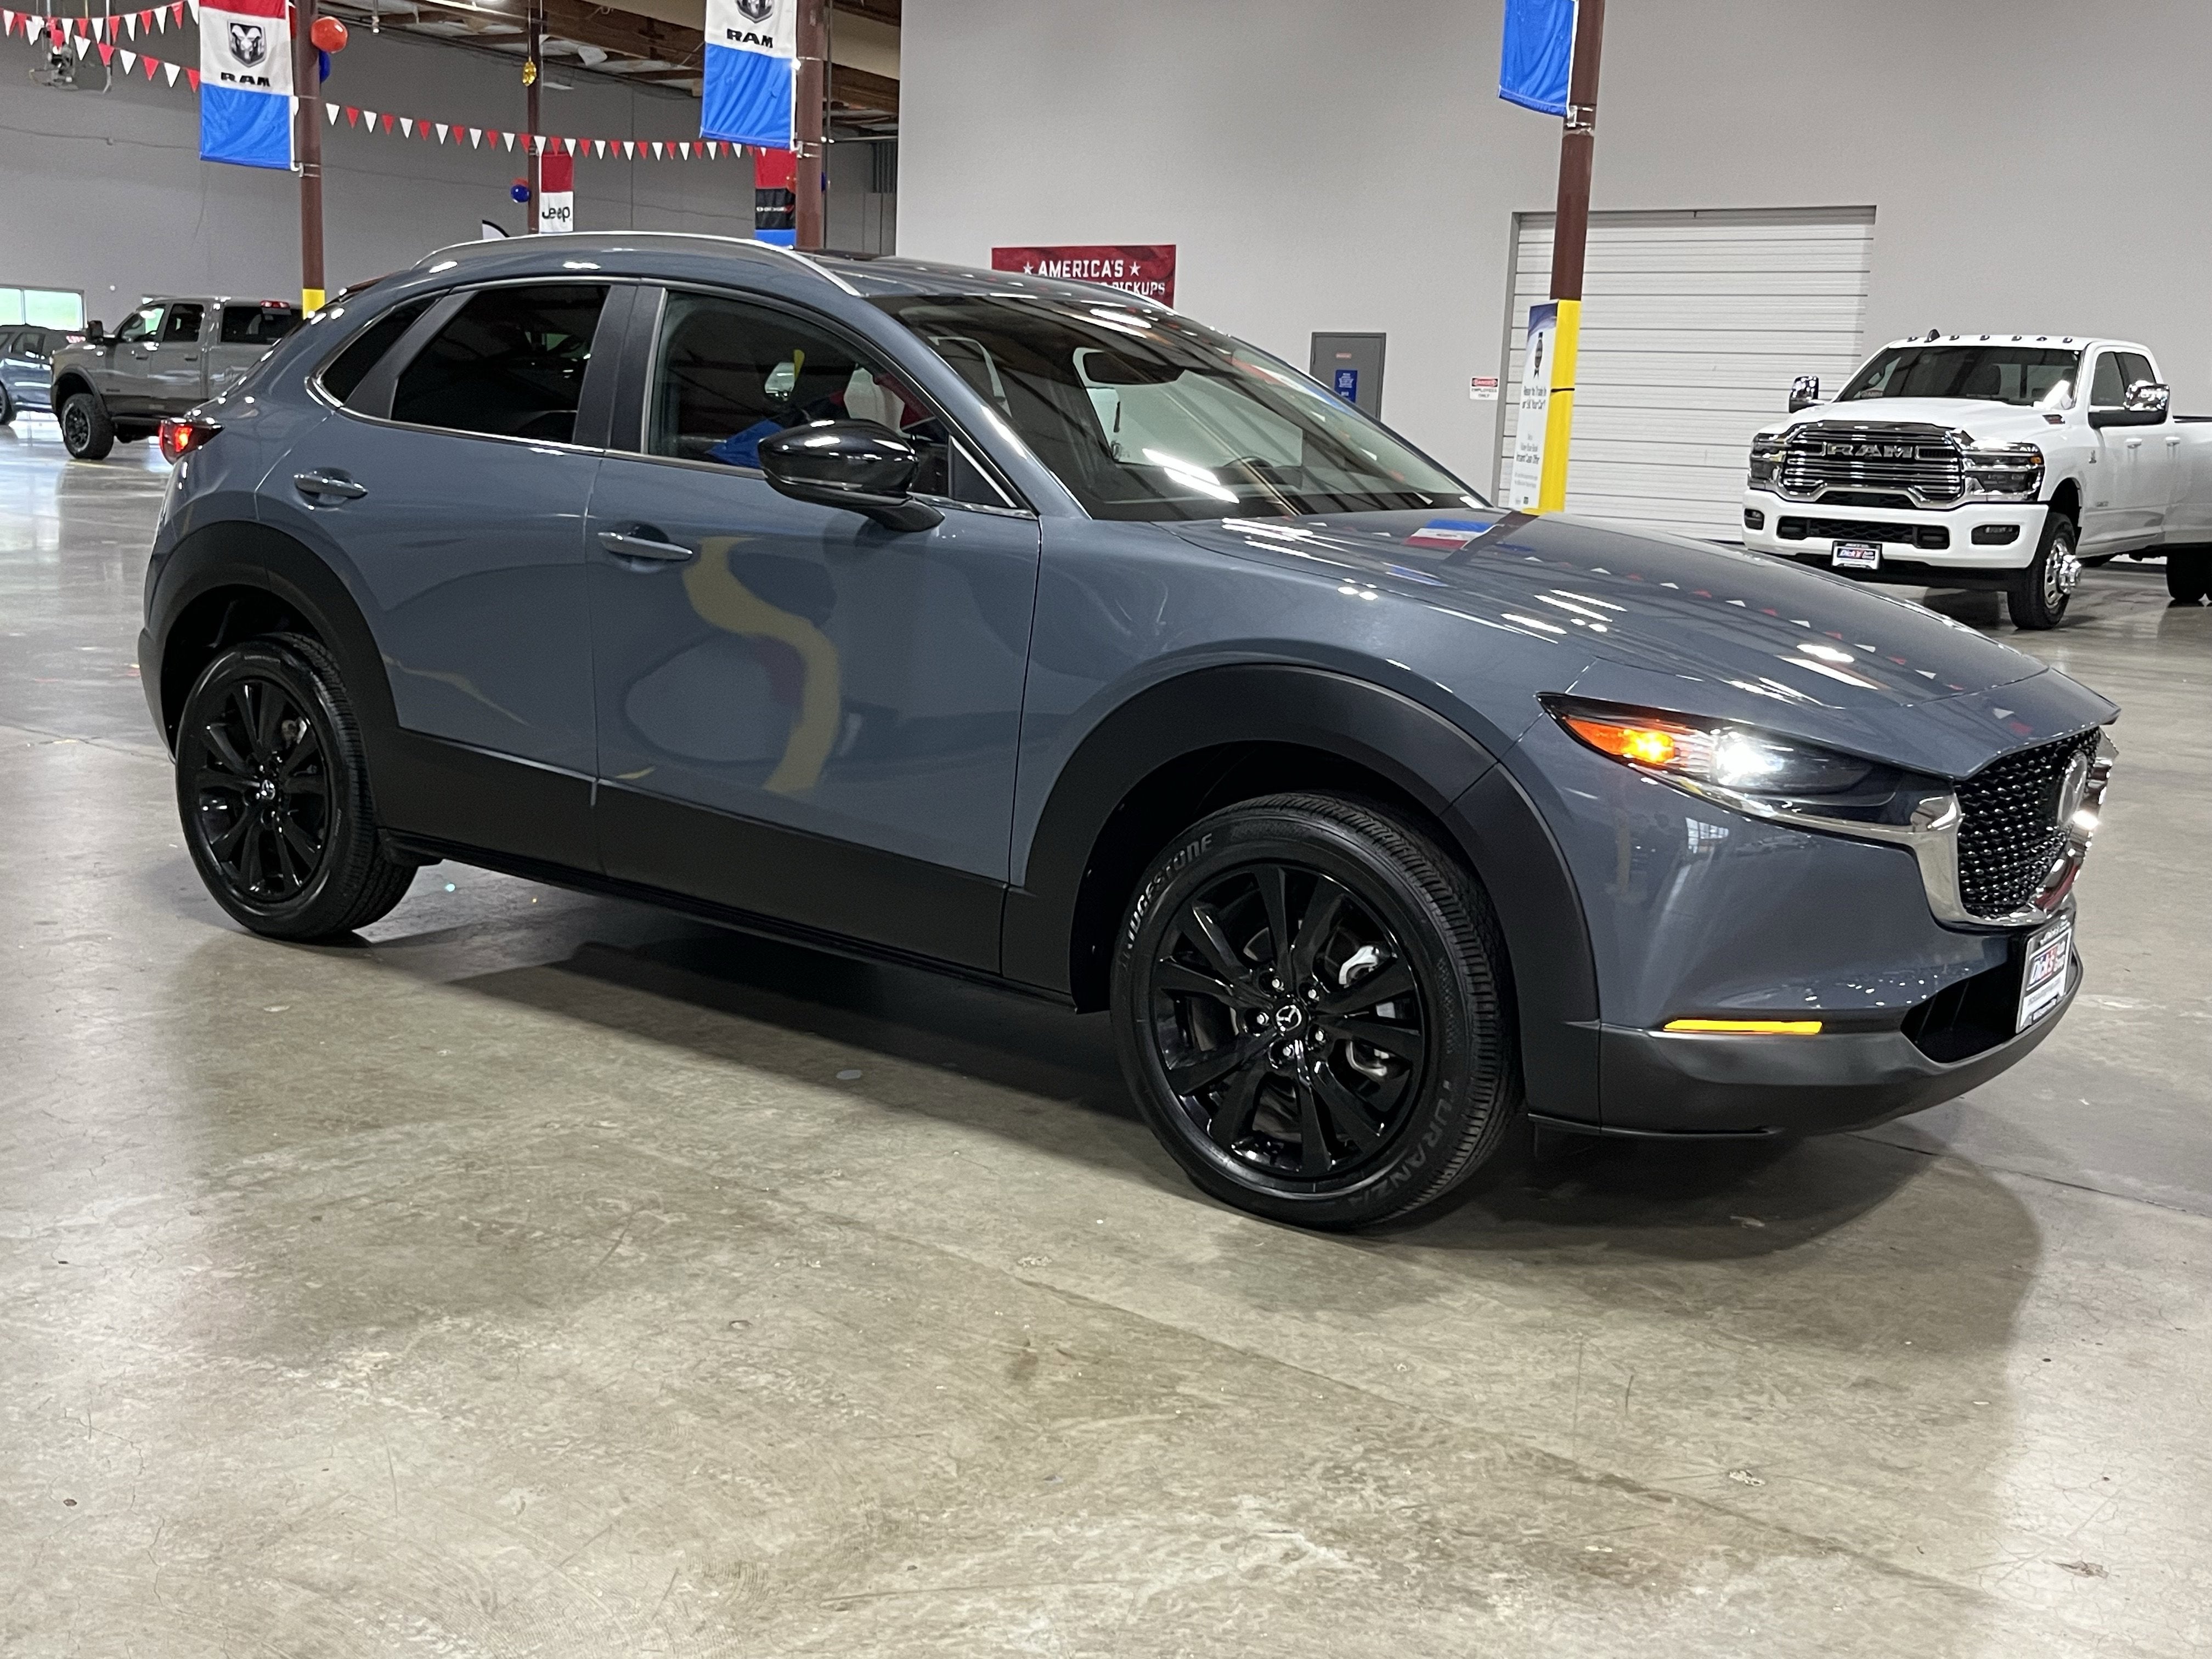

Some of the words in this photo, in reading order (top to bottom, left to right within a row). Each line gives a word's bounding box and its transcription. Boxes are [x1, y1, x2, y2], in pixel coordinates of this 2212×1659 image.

[726, 28, 774, 49] RAM
[221, 72, 270, 87] RAM
[541, 206, 570, 223] Jeep
[1038, 259, 1124, 278] AMERICA'S
[1827, 443, 1912, 459] RAM
[1122, 832, 1213, 972] IDGESTONE
